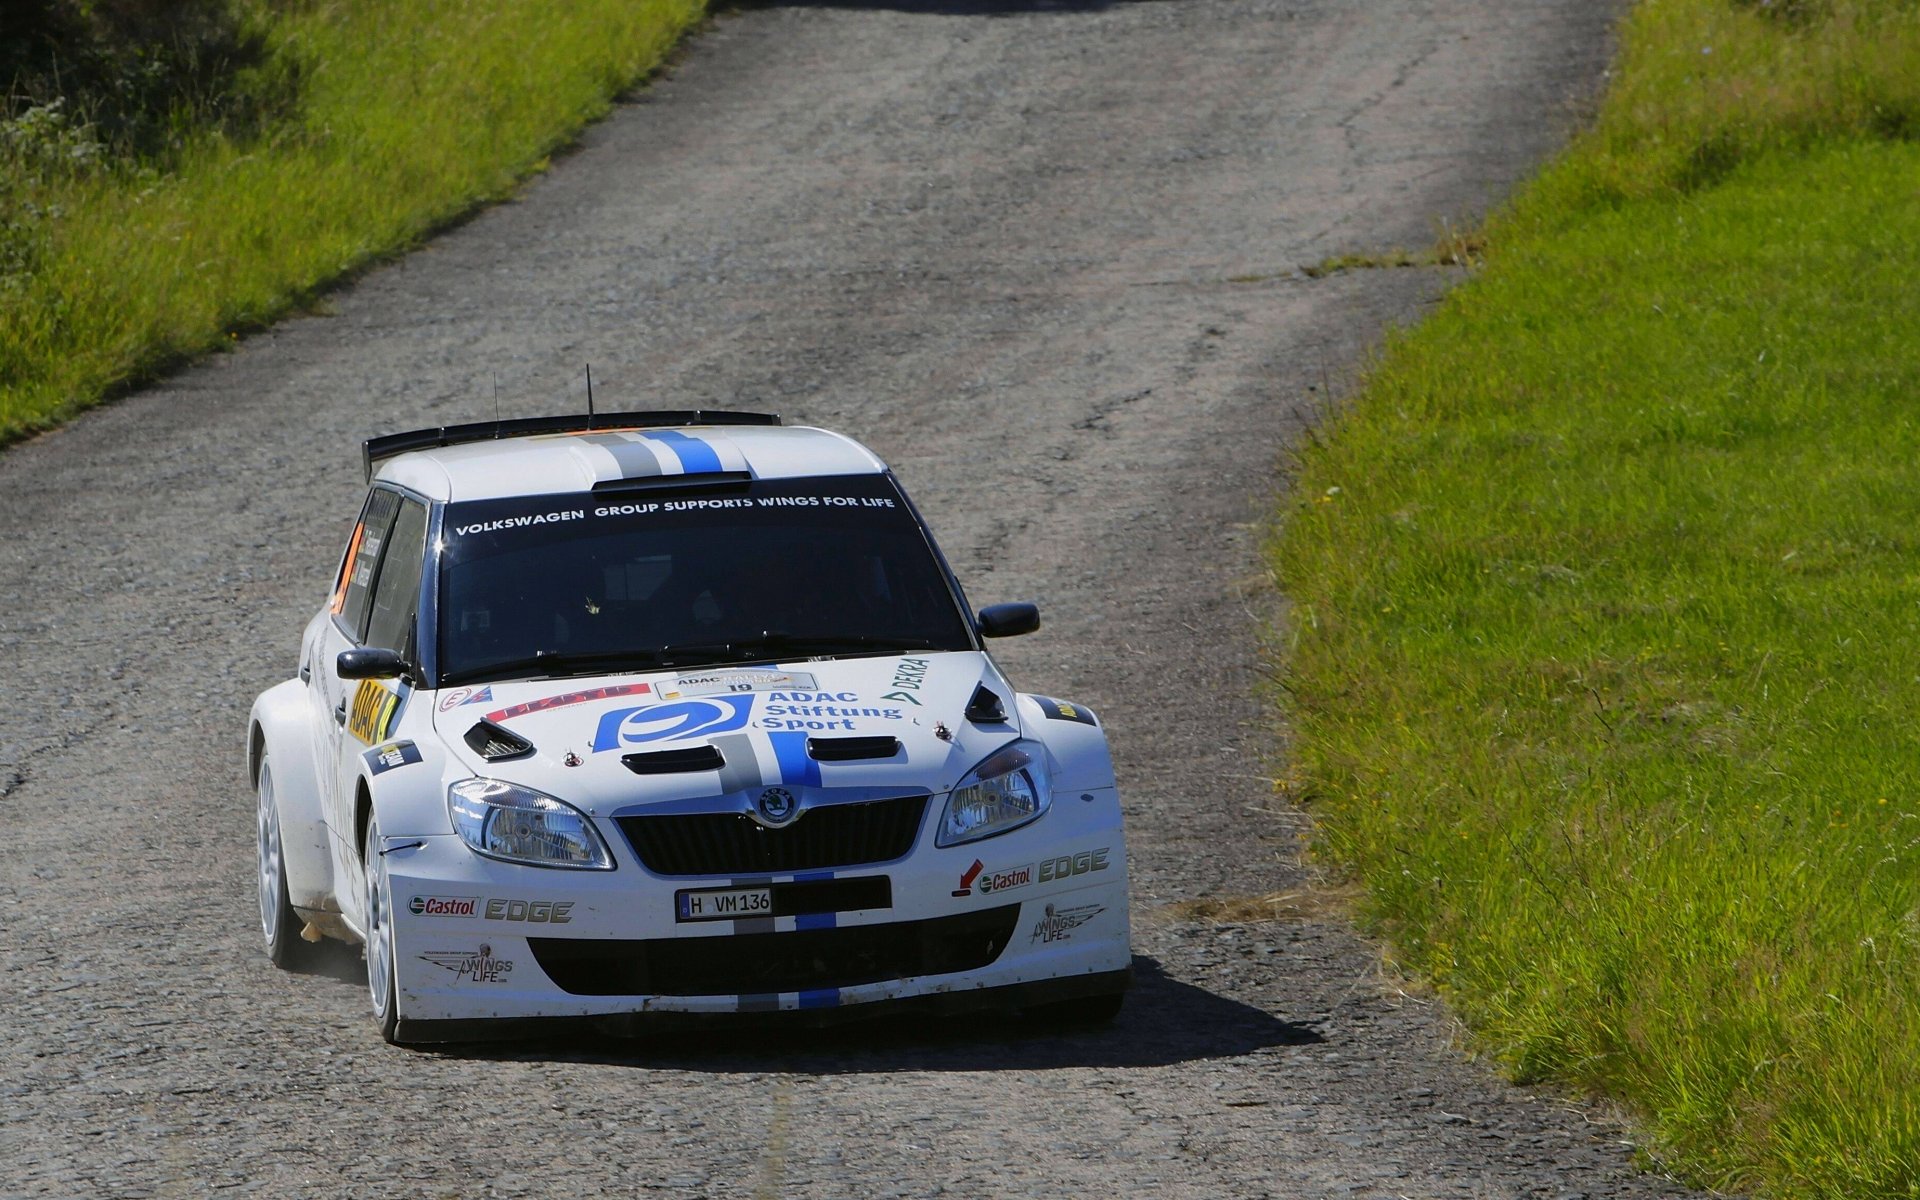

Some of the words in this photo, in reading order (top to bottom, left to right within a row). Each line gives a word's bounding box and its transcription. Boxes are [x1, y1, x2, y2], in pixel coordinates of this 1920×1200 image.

[455, 509, 585, 536] VOLKSWAGEN
[594, 502, 660, 517] GROUP
[664, 498, 754, 511] SUPPORTS
[757, 496, 820, 507] WINGS
[822, 496, 859, 507] FOR
[860, 496, 895, 508] LIFE
[678, 677, 721, 686] ADAC
[891, 658, 930, 690] DEKRA
[727, 684, 753, 692] 19
[768, 692, 859, 703] ADAC
[349, 679, 384, 742] ADAC
[765, 705, 903, 720] Stiftung
[762, 717, 856, 730] Sport
[992, 867, 1030, 891] Castrol
[1038, 847, 1110, 883] EDGE
[425, 898, 475, 915] Castrol
[484, 898, 576, 924] EDGE
[691, 897, 702, 914] H
[465, 957, 513, 973] WINGS
[472, 970, 499, 983] LIFE
